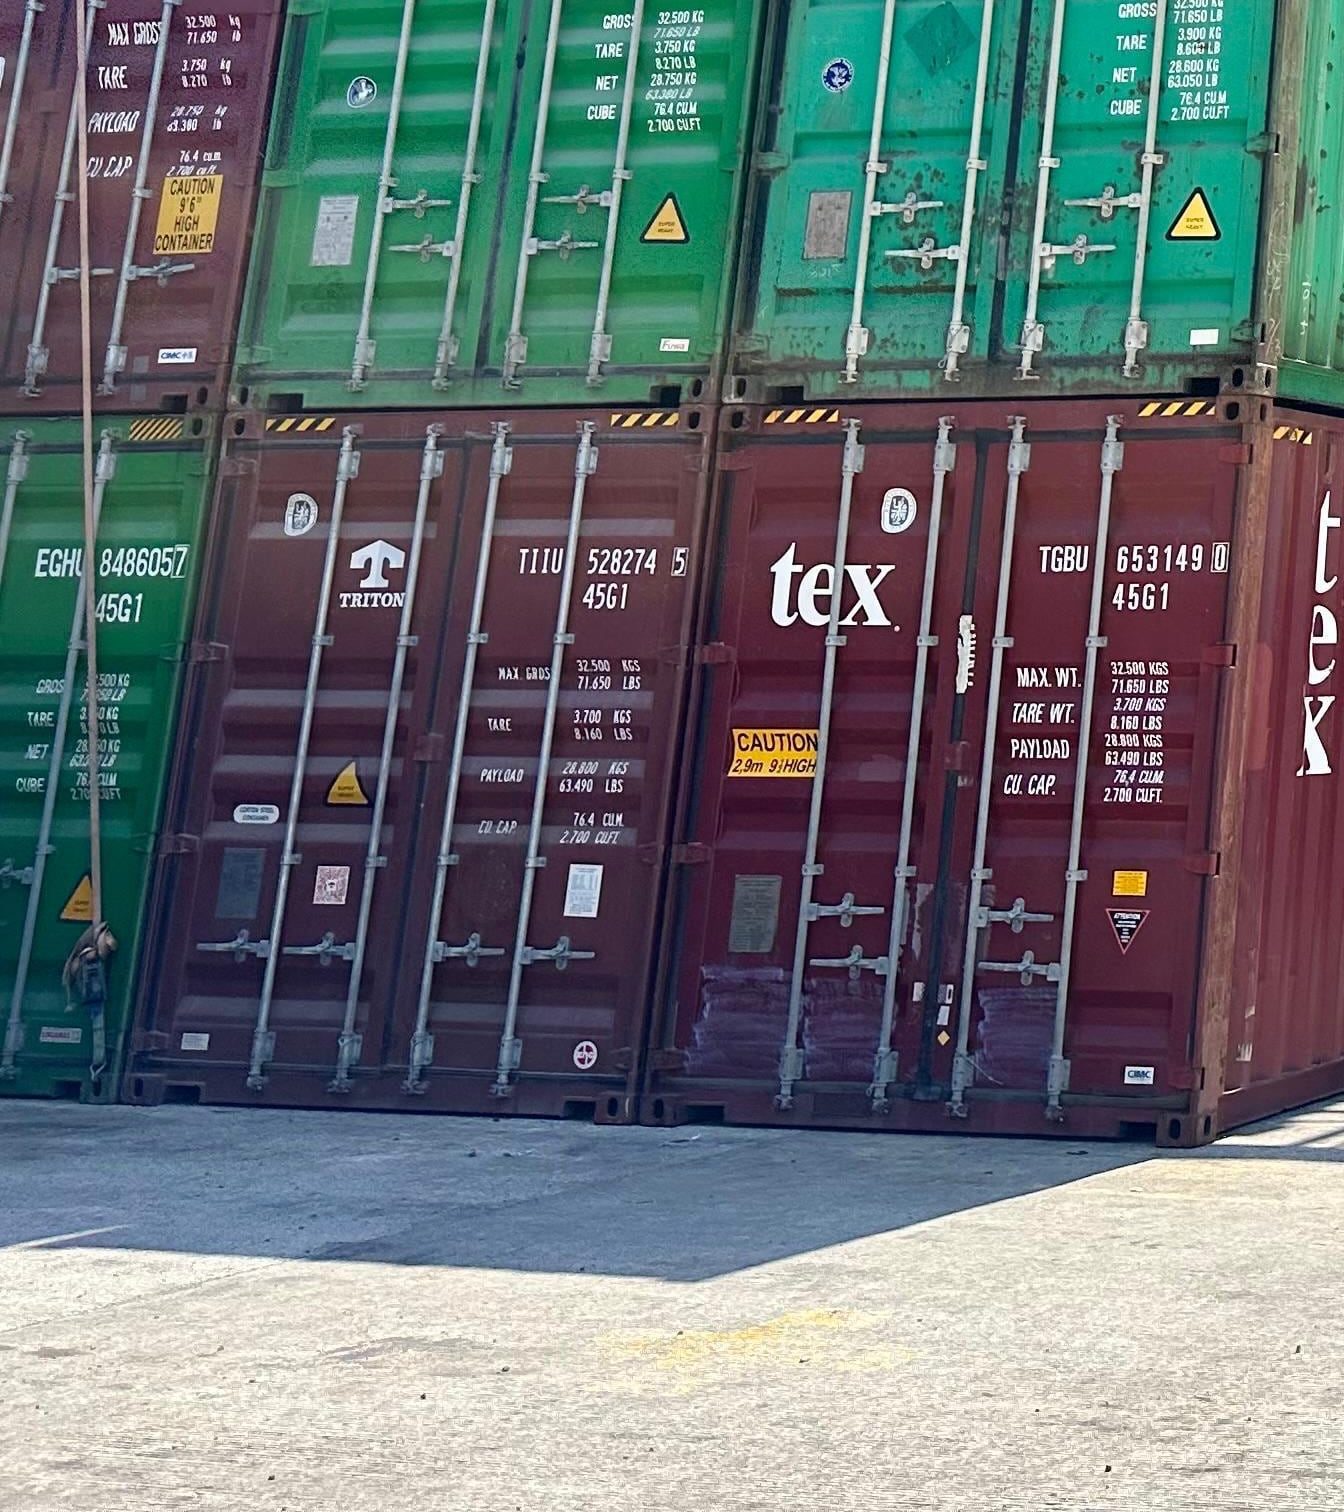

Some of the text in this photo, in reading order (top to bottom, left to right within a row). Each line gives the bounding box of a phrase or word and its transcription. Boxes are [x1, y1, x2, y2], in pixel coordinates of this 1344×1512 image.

[1118, 2, 1157, 19] GROSS
[1116, 34, 1147, 50] TARE
[1177, 26, 1222, 42] 3.900 KG
[1113, 67, 1137, 83] NET
[1168, 59, 1220, 74] 28.600 KG
[1110, 99, 1141, 116] CUBE
[169, 179, 215, 196] CAUTION
[173, 215, 200, 233] HIGH
[35, 548, 85, 578] EGHU
[519, 548, 688, 576] TIIU 528274 5
[1038, 544, 1227, 575] TGBU 653149 0
[769, 541, 897, 628] tex
[339, 591, 405, 609] TRITON
[582, 583, 628, 610] 45G1
[1112, 582, 1169, 612] 45G1
[95, 594, 142, 624] 45G1
[1296, 490, 1341, 778] tex
[1110, 660, 1169, 677] 32.500 KGS
[1016, 667, 1082, 689] MAX. WT.
[1111, 677, 1169, 695] 71.650 LBS
[1012, 701, 1075, 724] TARE WT.
[1112, 697, 1166, 713] 3.700 KGS
[1110, 714, 1163, 731] 8.160 LBS
[736, 731, 818, 754] CAUTION
[1010, 738, 1071, 760] PAYLOAD
[1104, 732, 1163, 750] 28.800 KGS
[732, 758, 764, 775] 2,9m
[1104, 750, 1164, 767] 63.490 LBS
